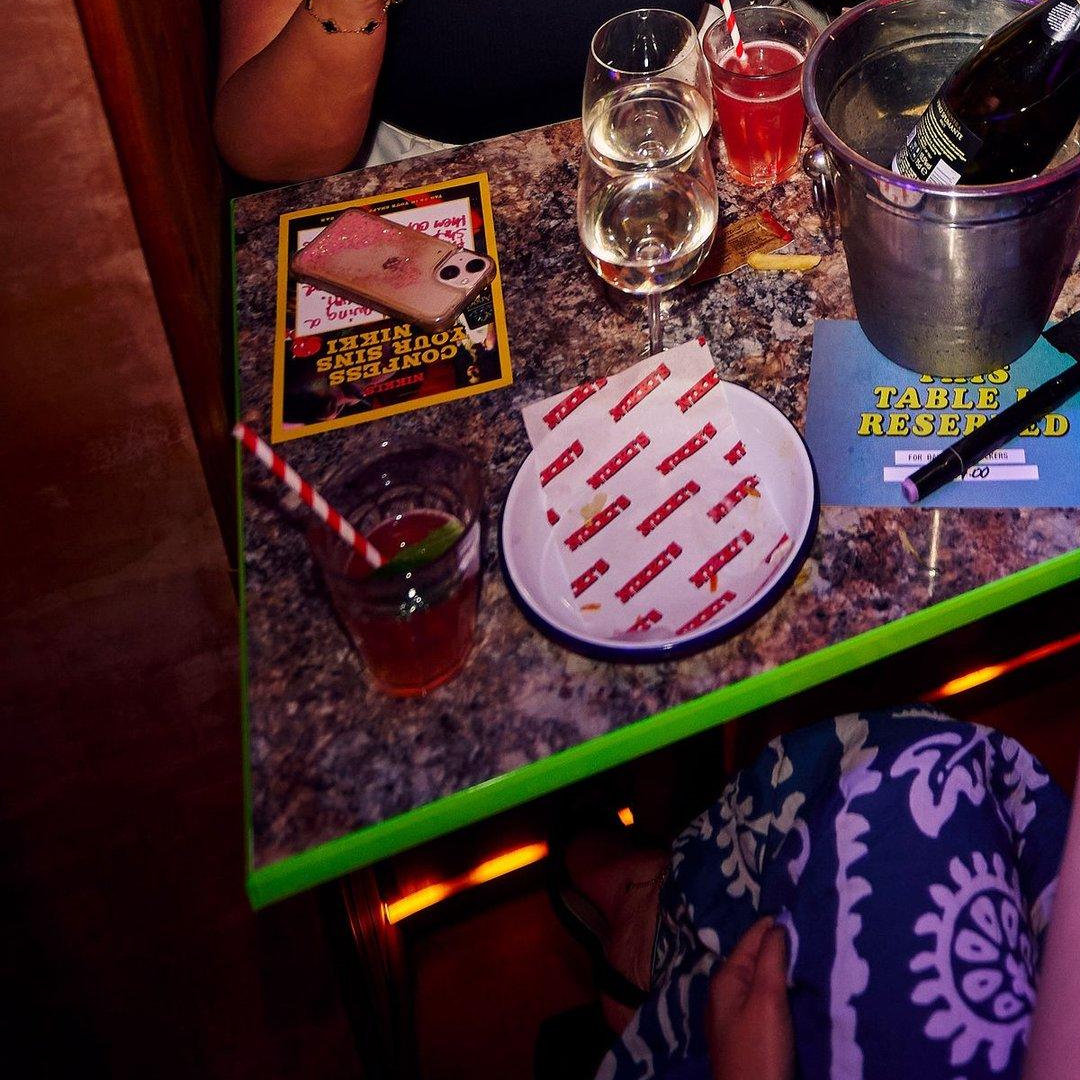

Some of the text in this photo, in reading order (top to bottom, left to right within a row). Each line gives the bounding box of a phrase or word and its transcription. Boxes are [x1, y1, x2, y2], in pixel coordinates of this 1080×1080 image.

[316, 327, 467, 373] YOUR SINS
[327, 324, 413, 356] NIKKI
[328, 345, 458, 387] CONFESS
[873, 386, 1000, 410] TABLE
[857, 413, 1071, 437] RESERED
